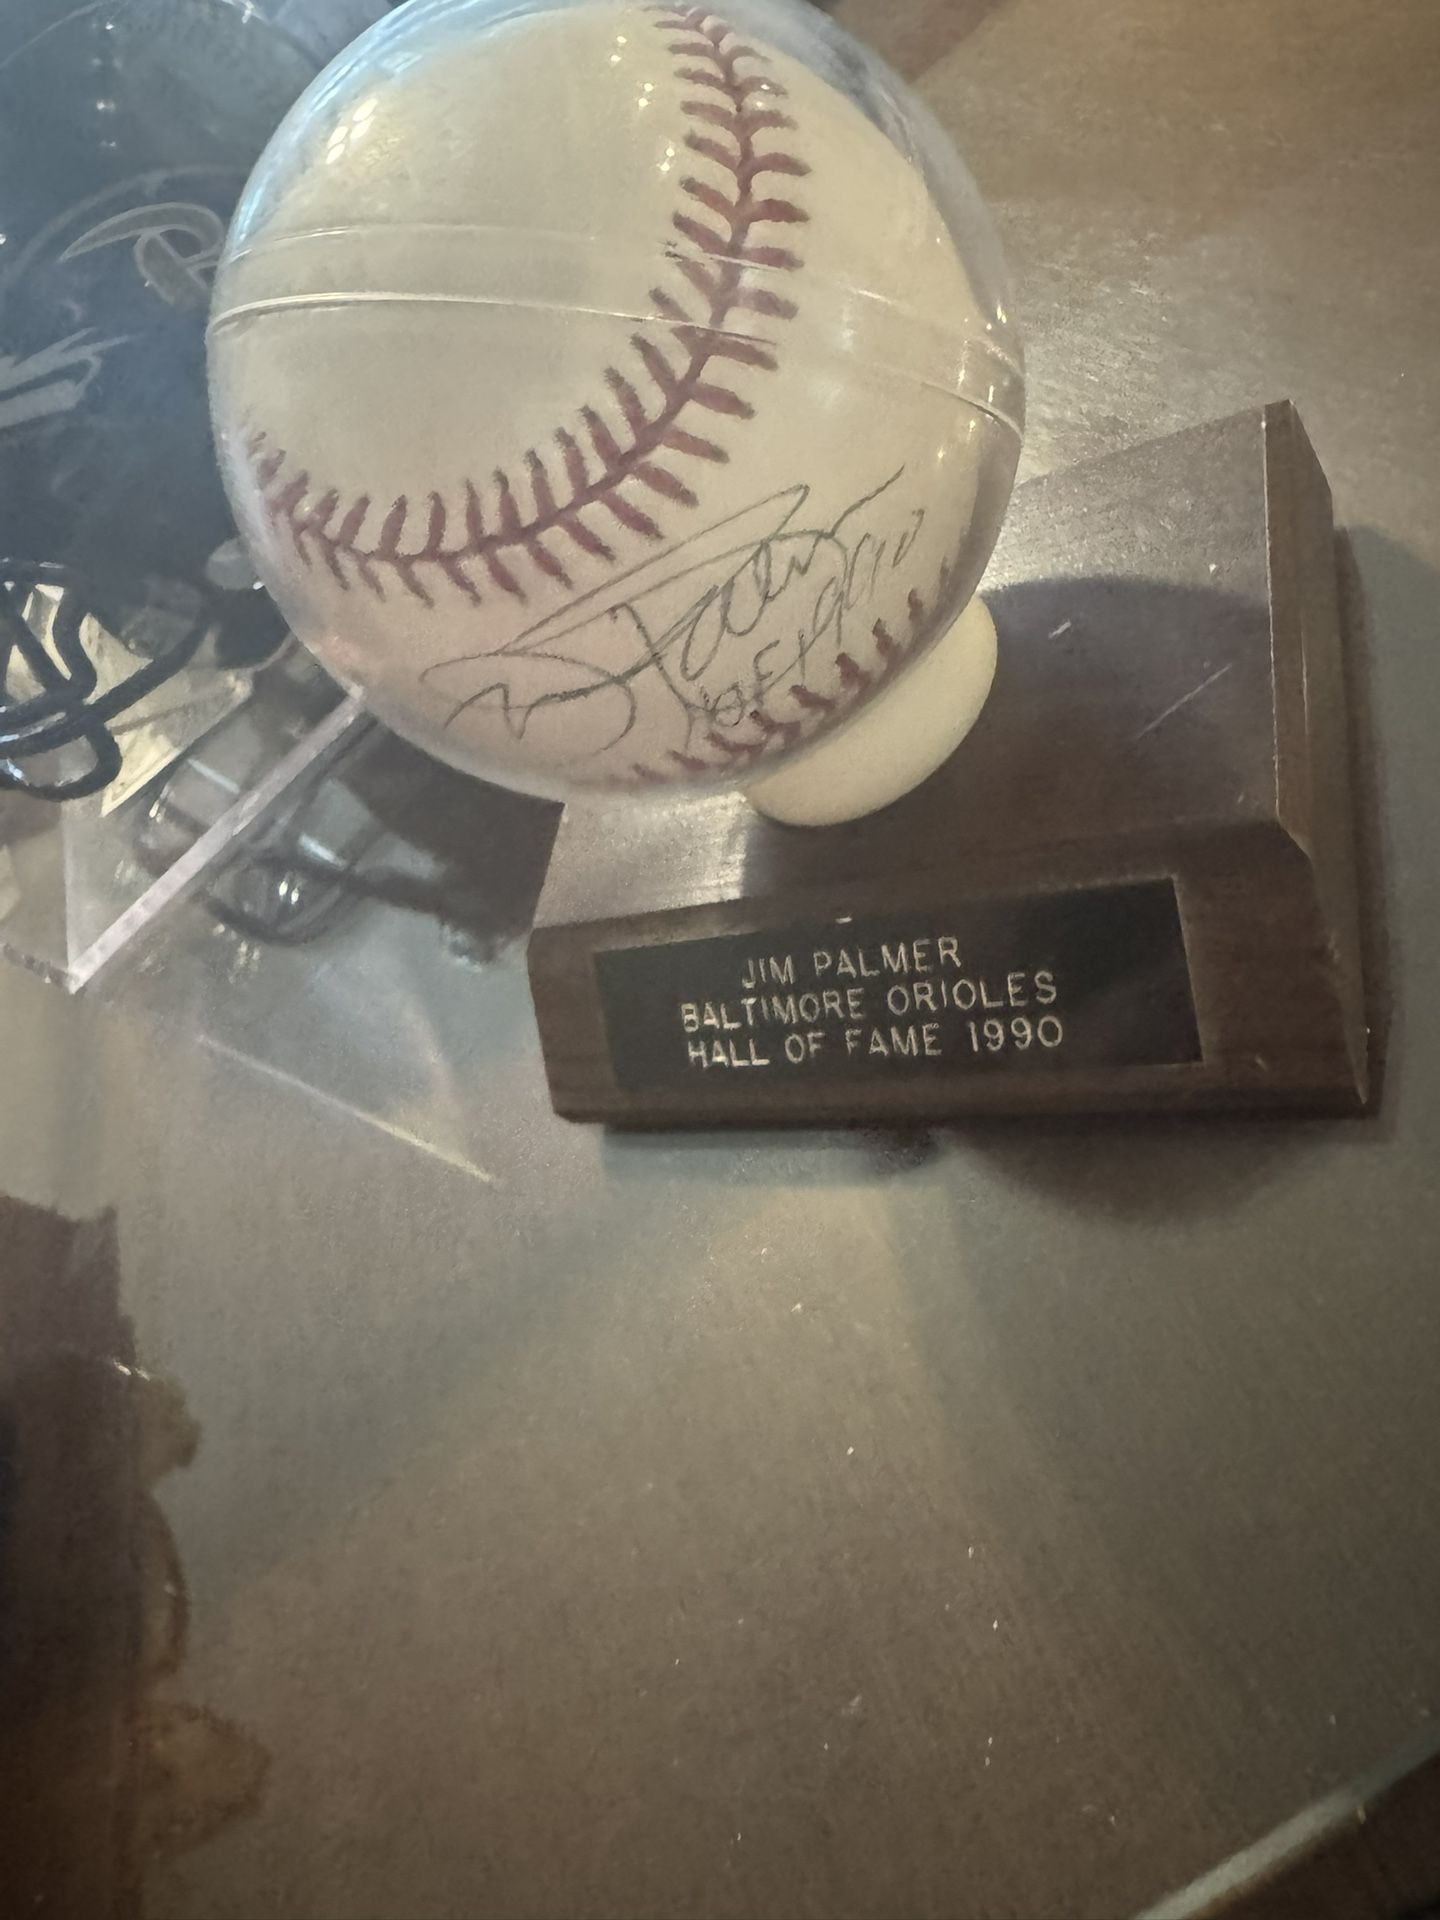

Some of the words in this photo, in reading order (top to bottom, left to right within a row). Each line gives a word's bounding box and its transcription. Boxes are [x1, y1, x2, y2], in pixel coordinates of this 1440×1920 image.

[742, 955, 794, 988] JIM
[813, 936, 961, 977] PALMER
[681, 988, 865, 1033] BALTIMORE
[886, 970, 1058, 1014] ORIOLES
[687, 1038, 770, 1068] HALL
[785, 1032, 825, 1064] OF
[845, 1024, 943, 1057] FAME
[969, 1014, 1064, 1053] 1990
